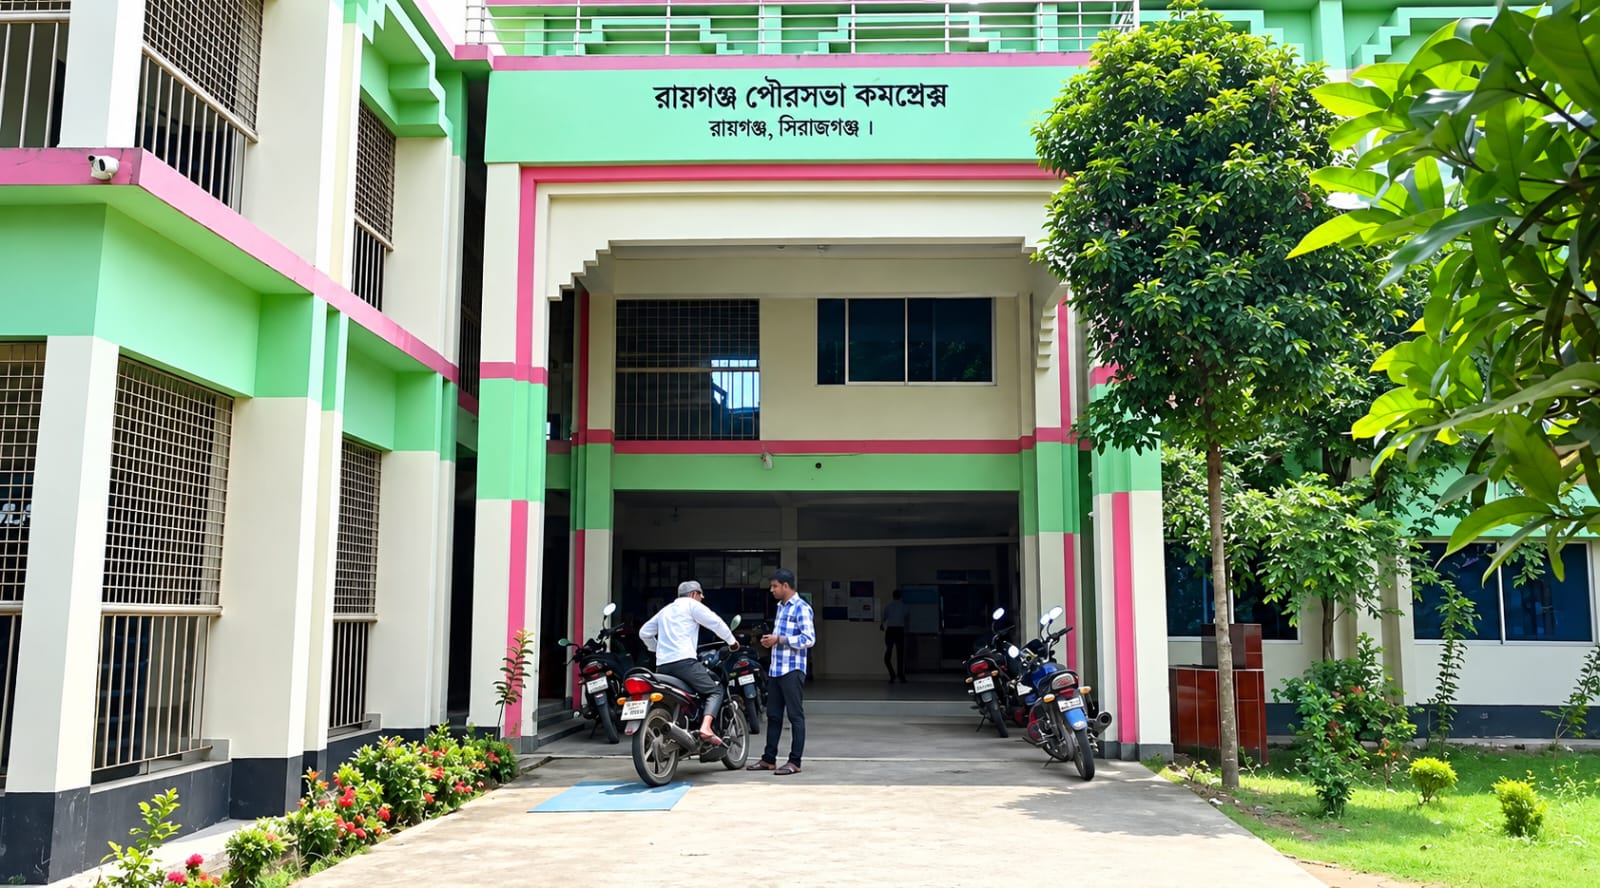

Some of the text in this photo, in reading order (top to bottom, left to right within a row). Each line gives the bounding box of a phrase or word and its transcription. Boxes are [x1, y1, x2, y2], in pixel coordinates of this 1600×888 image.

[653, 84, 737, 109] রায়গঞ্জ
[746, 76, 847, 108] পৌরসভা
[709, 119, 773, 140] রায়গঞ্জ,
